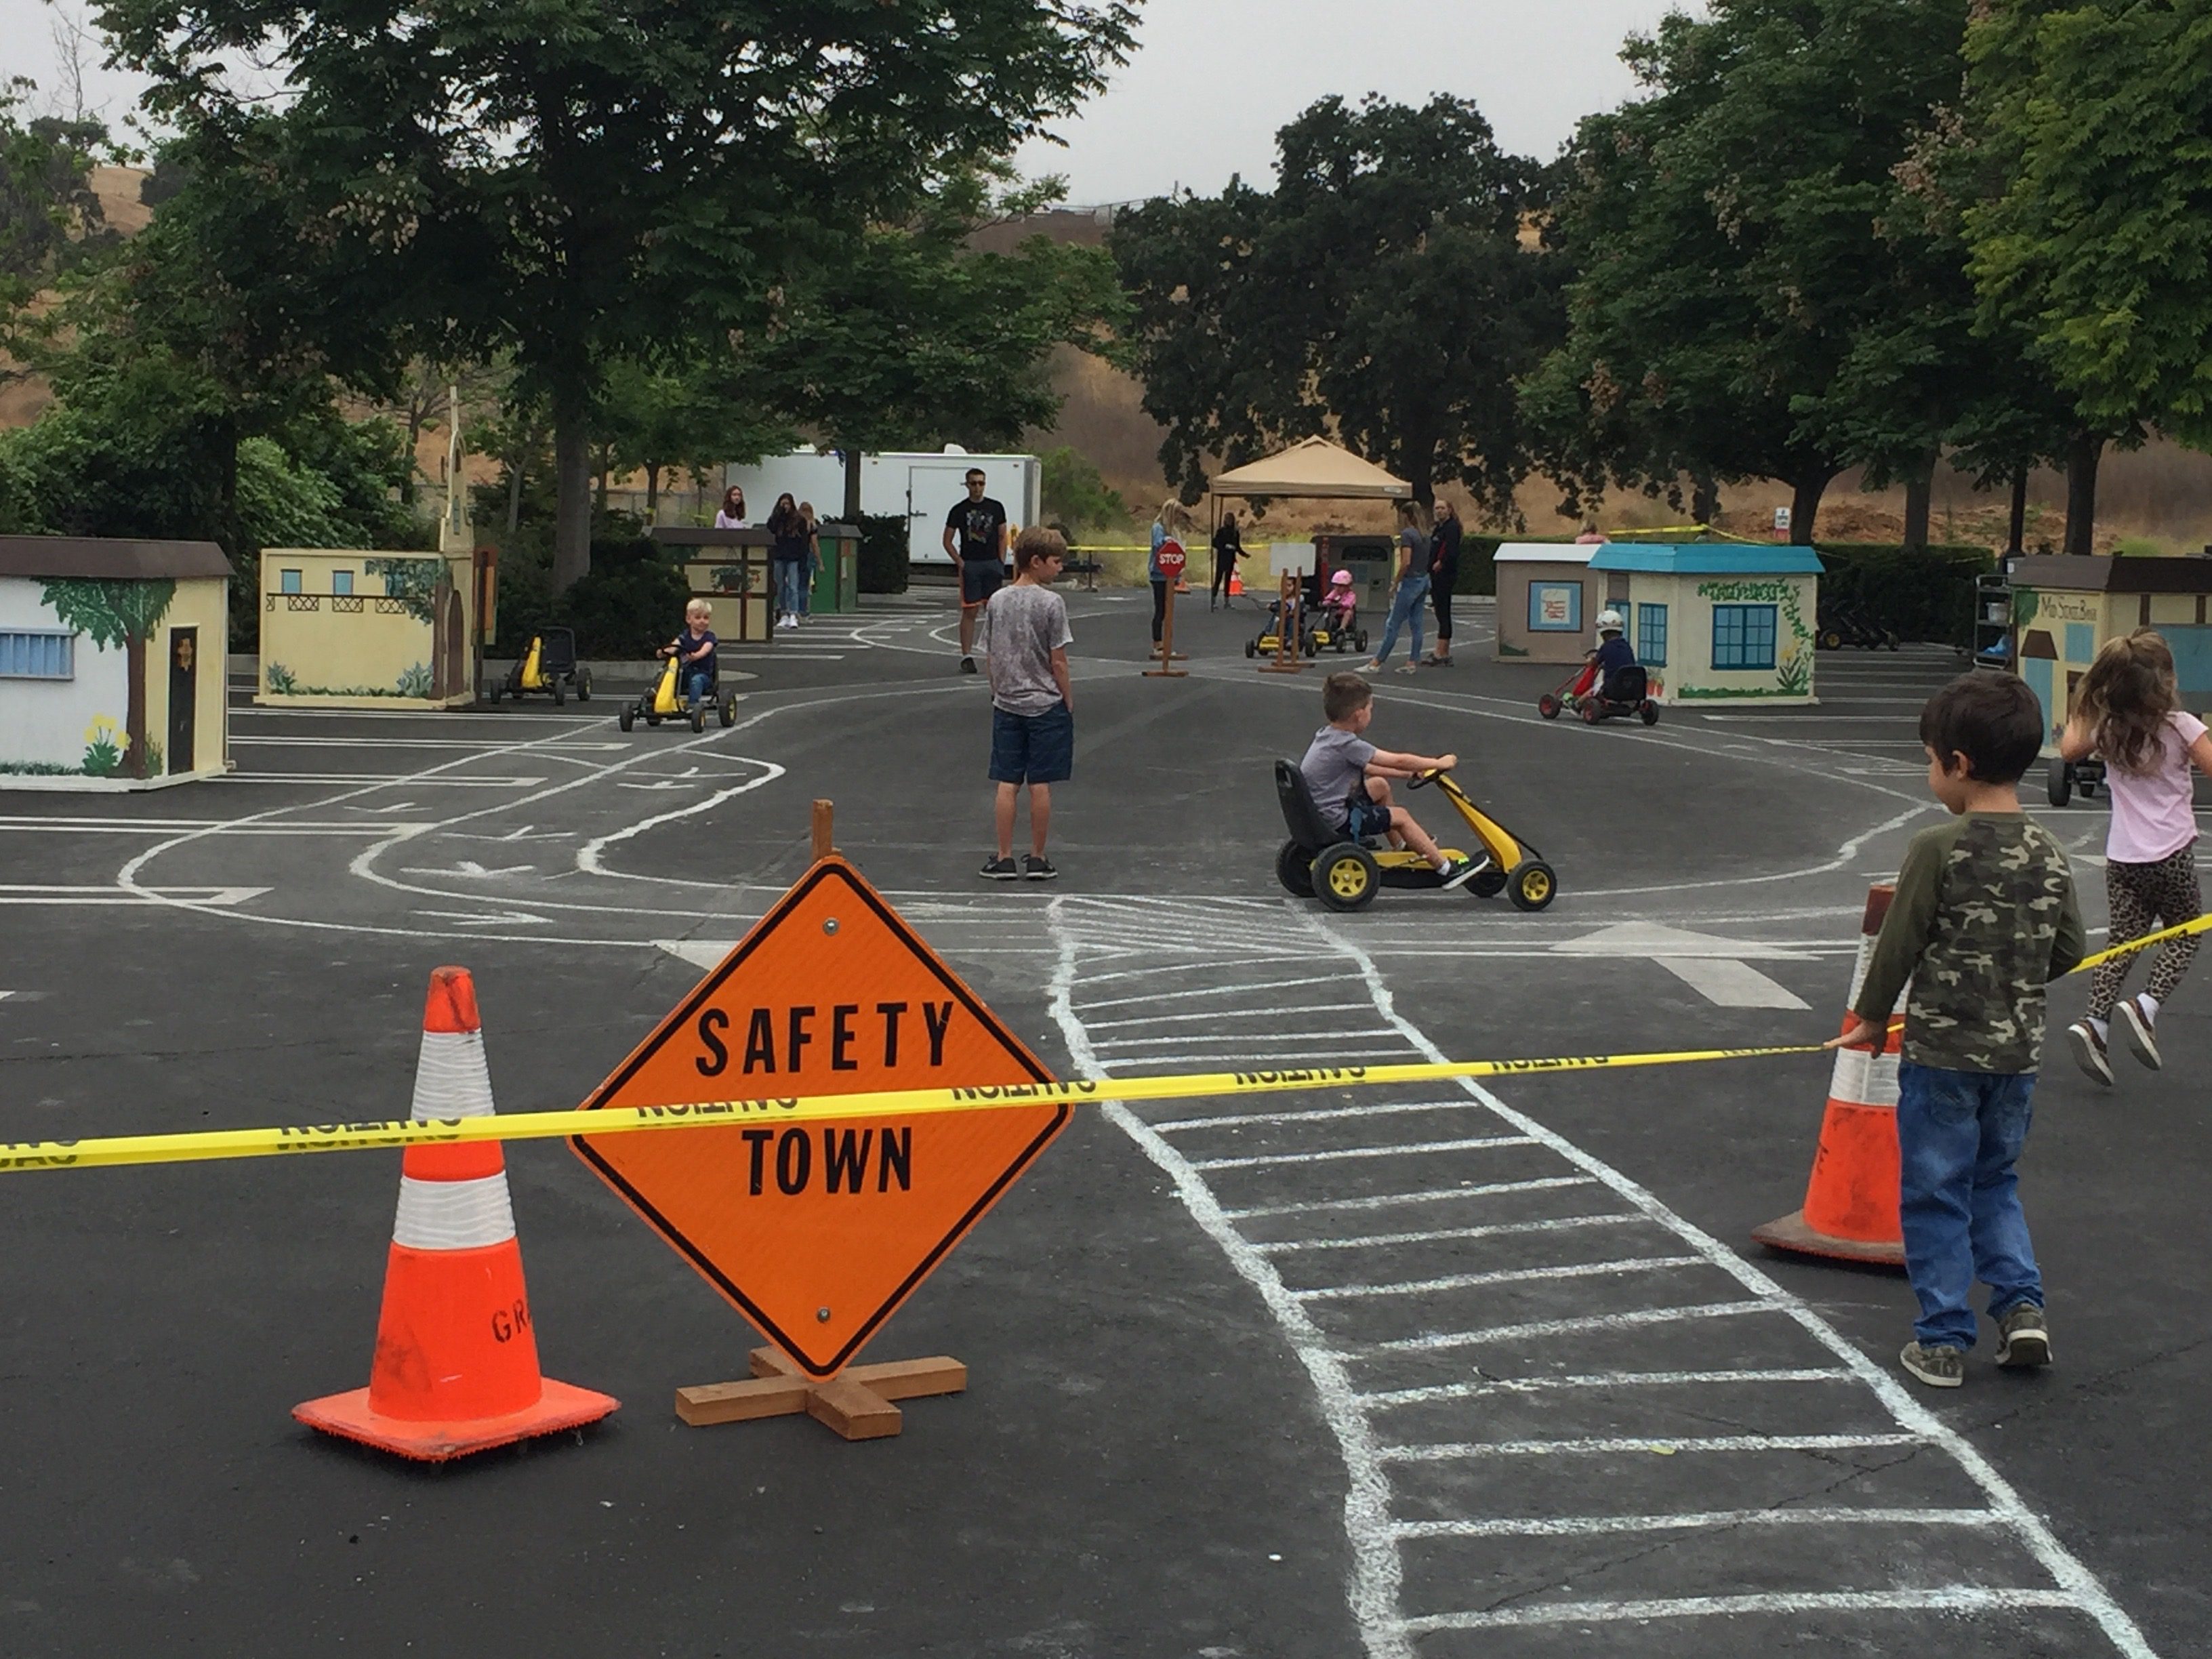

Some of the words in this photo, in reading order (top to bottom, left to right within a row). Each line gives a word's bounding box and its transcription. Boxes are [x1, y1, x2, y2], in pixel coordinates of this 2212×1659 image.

[1159, 553, 1185, 565] STOP
[695, 1001, 954, 1076] SAFETY
[741, 1126, 912, 1195] TOWN
[491, 1298, 531, 1343] GR
